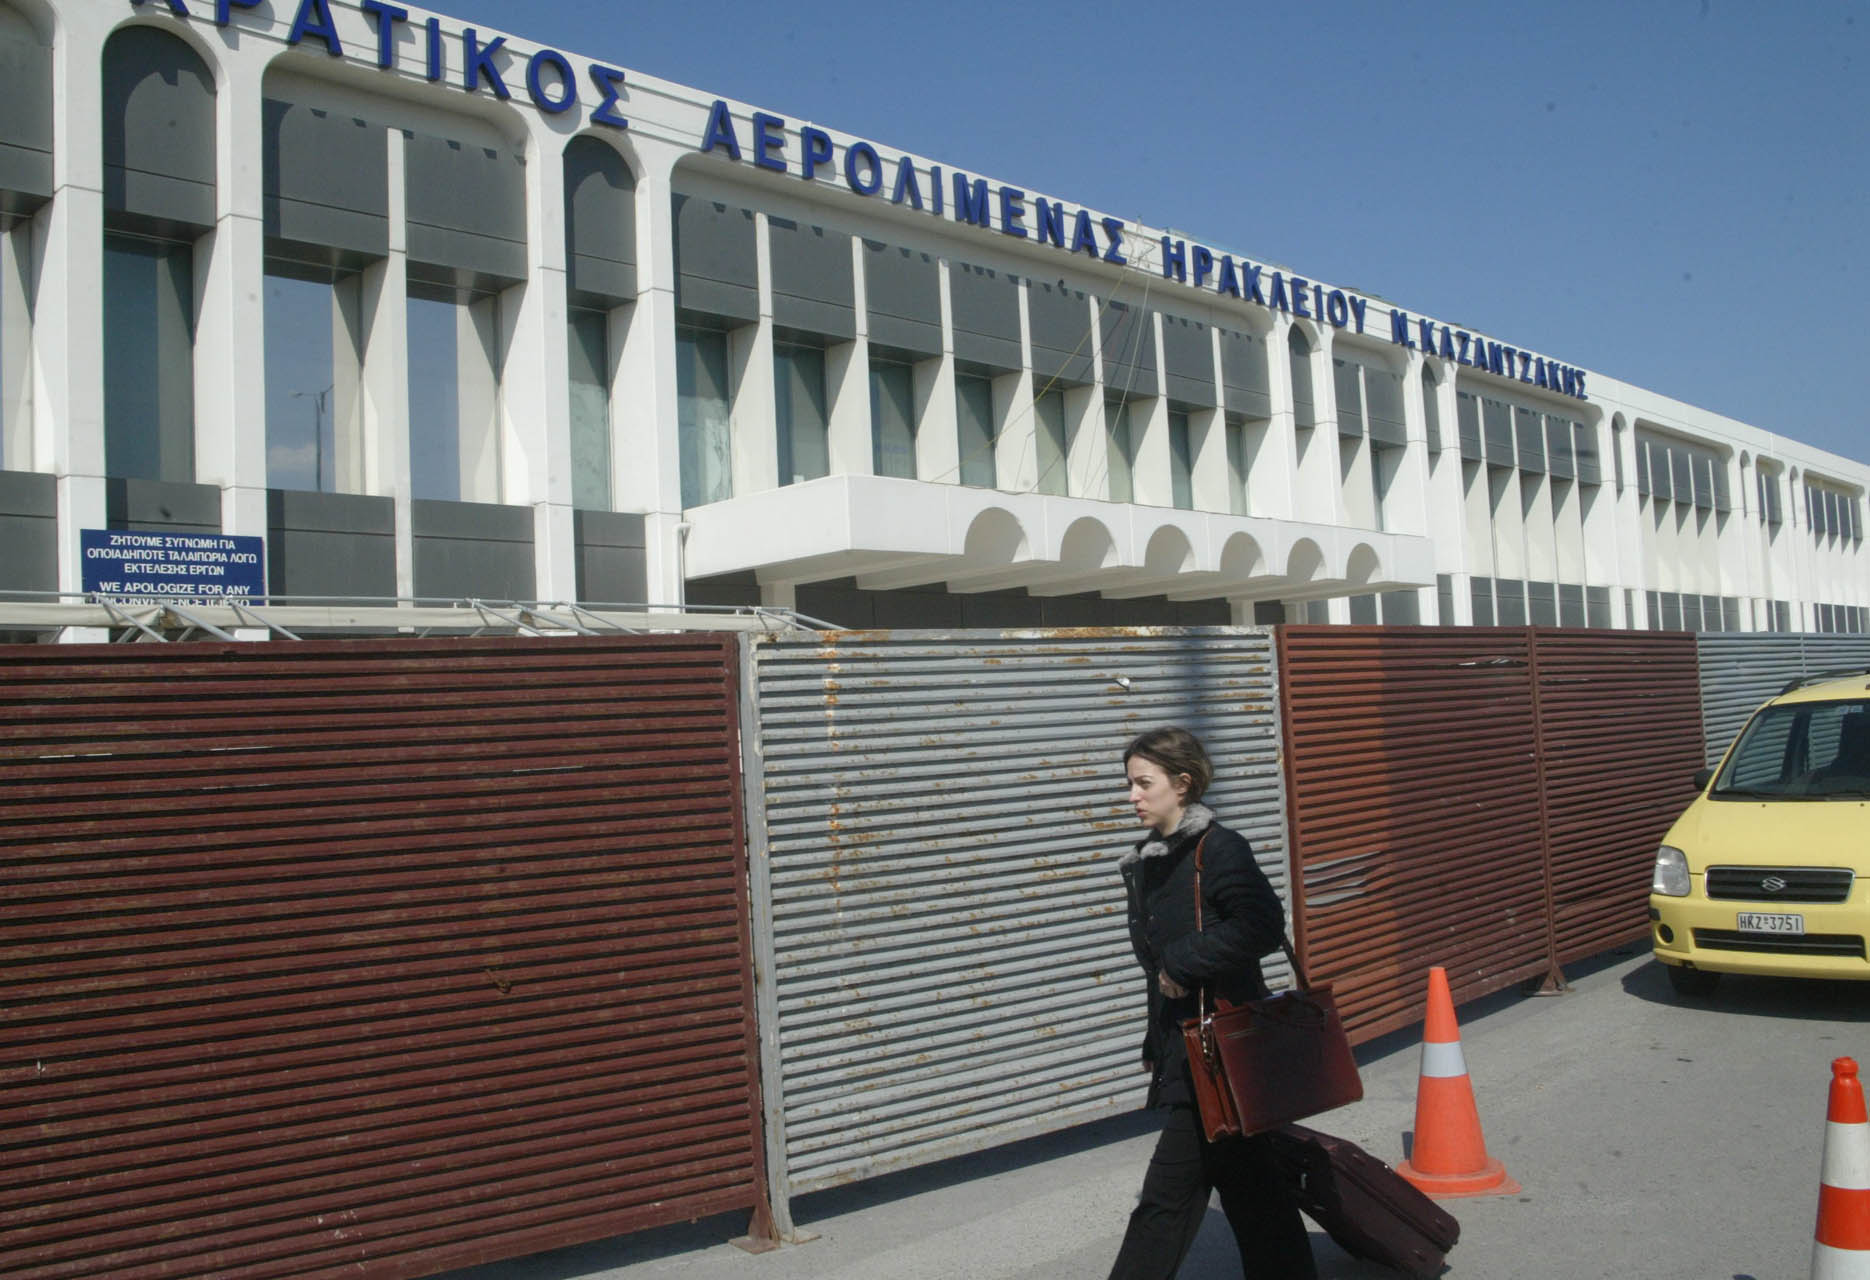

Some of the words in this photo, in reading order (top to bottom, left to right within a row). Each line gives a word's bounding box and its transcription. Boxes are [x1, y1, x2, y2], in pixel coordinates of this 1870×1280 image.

[129, 0, 628, 129] ΑΤΙΚΟΣ
[700, 100, 1127, 265] ΑΕΡΟΛΙΜΕΝΑΣ
[1161, 236, 1367, 334] ΗΡΑΚΛΕΙΟΥ
[110, 535, 163, 547] ΖΗΤΟΥΜΕ
[165, 537, 217, 549] ΣΥΓΝΩΜΗ
[219, 539, 236, 550] ΓΙΑ
[87, 548, 165, 560] ΟΠΟΙΑΔΗΠΟΤΕ
[168, 551, 228, 562] ΤΑΛΑΙΠΩΡΙΑ
[230, 553, 257, 563] ΛΟΓΩ
[124, 563, 188, 574] ΕΚΤΕΛΕΣΗΣ
[189, 565, 225, 575] ΕΡΓΩΝ
[99, 581, 121, 592] WE
[124, 582, 195, 594] APOLOGIZE
[198, 584, 223, 595] FOR
[226, 585, 250, 595] ANY
